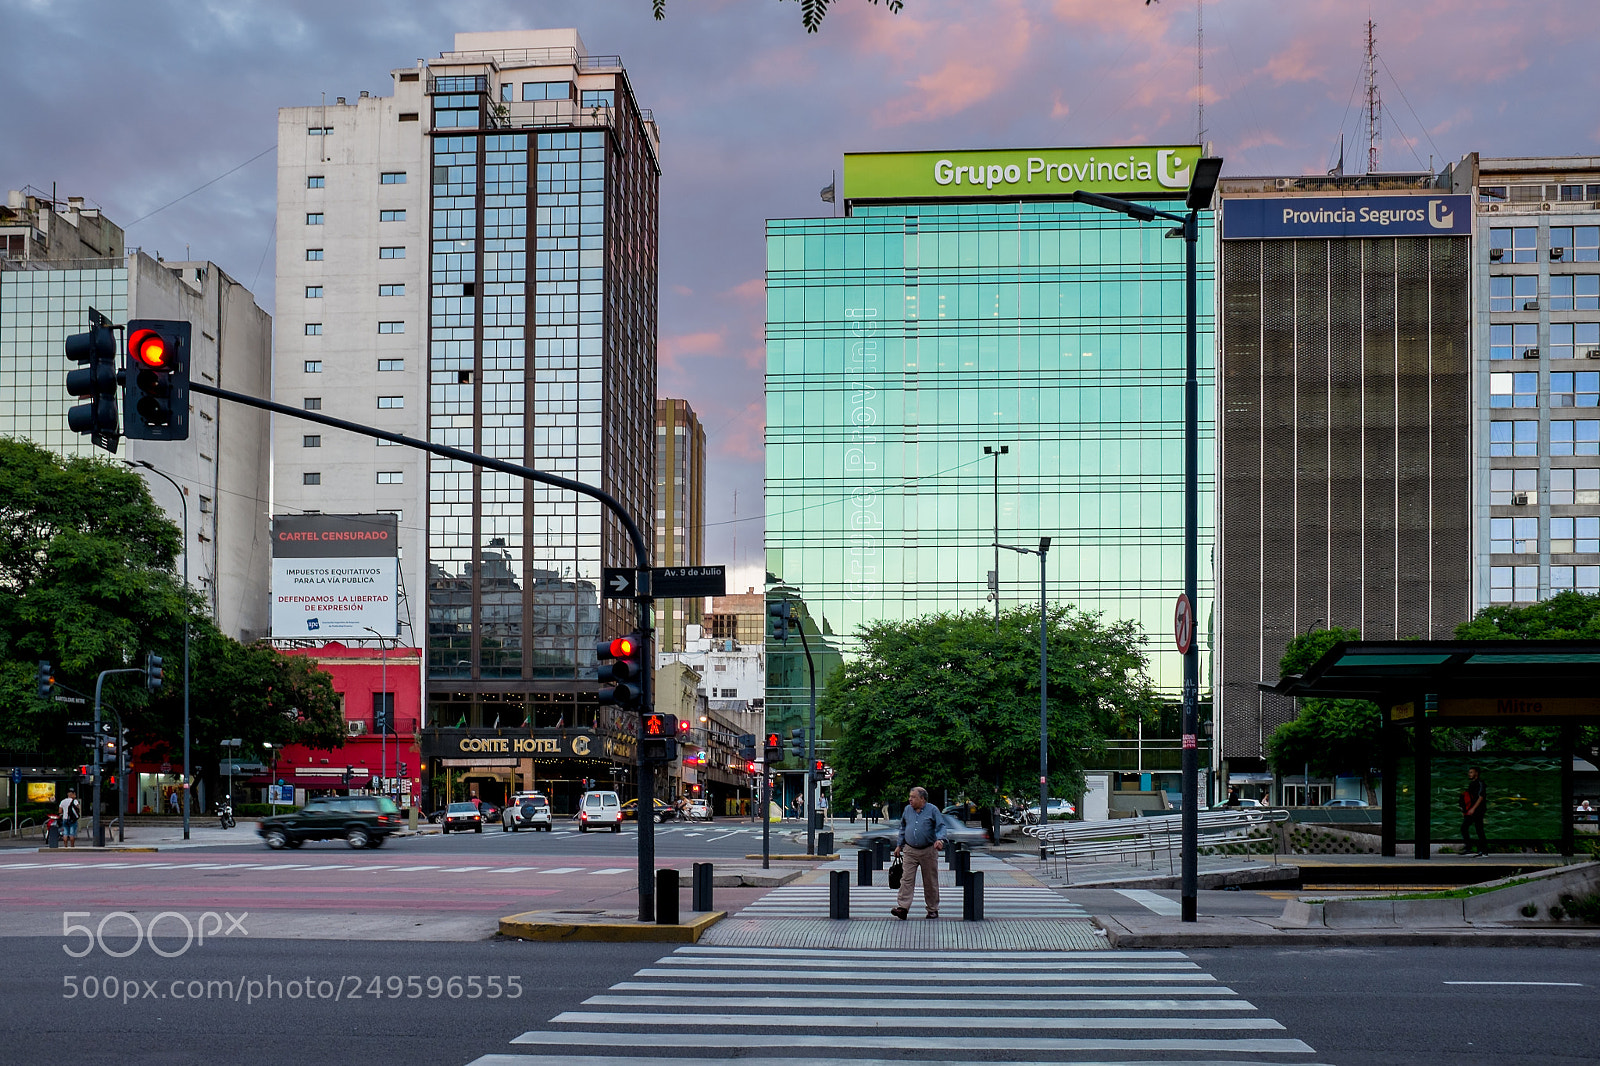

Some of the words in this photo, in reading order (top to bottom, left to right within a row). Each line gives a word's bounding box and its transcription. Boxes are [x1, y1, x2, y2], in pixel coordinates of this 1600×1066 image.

[935, 160, 1021, 189] Grupo
[1027, 156, 1152, 183] Provincia
[1283, 208, 1356, 224] Provincia
[1359, 207, 1425, 226] Seguros
[279, 532, 319, 541] CARTEL
[321, 531, 388, 540] CENSURADO
[844, 486, 883, 602] Grupo
[664, 569, 679, 577] Av.
[700, 568, 722, 576] Julio
[318, 603, 363, 611] EXPRESIÓN
[1497, 699, 1543, 714] Mitre
[459, 738, 508, 752] CONTE
[514, 738, 561, 752] HOTEL
